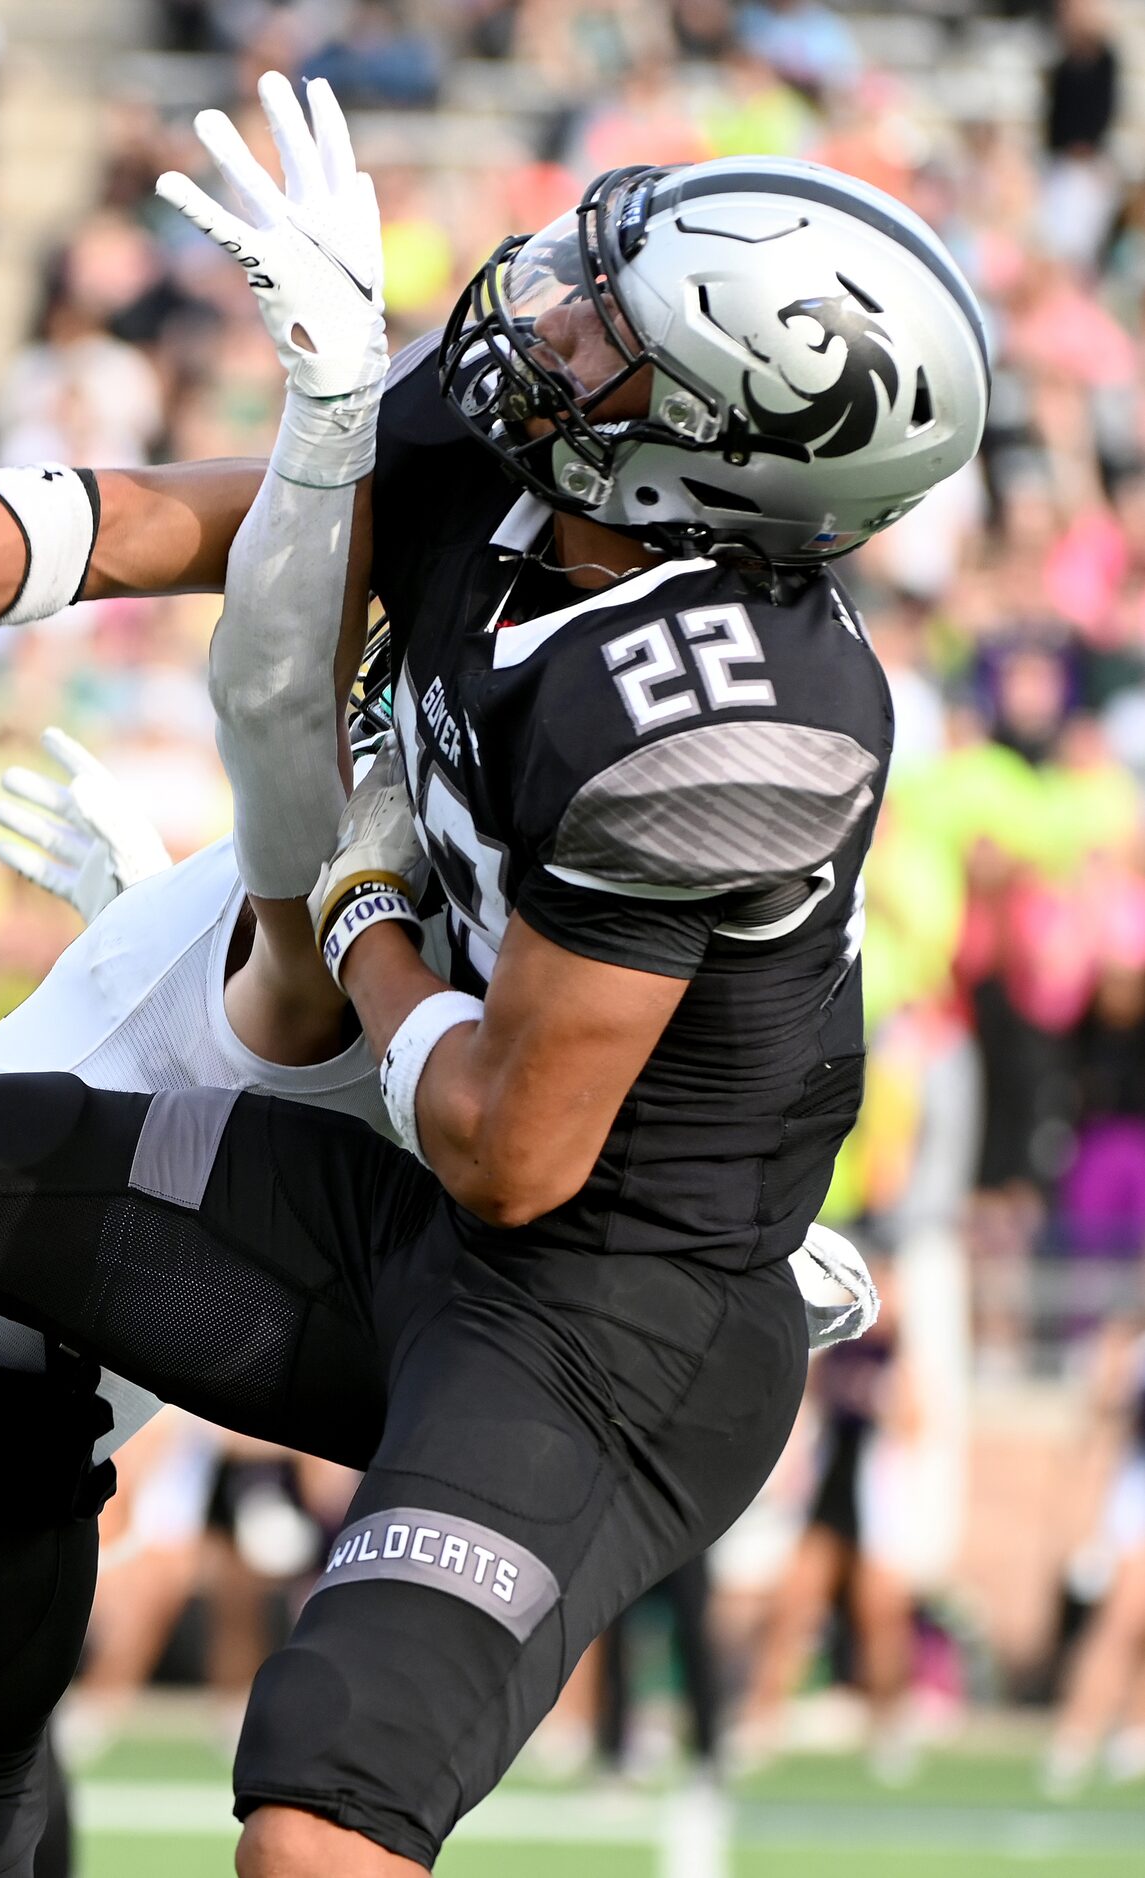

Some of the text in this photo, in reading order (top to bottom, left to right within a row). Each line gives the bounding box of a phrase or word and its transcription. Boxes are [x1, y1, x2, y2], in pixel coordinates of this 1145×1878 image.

[601, 602, 776, 736] 22
[421, 675, 461, 768] GUYER
[326, 1523, 519, 1604] WILDCATS
